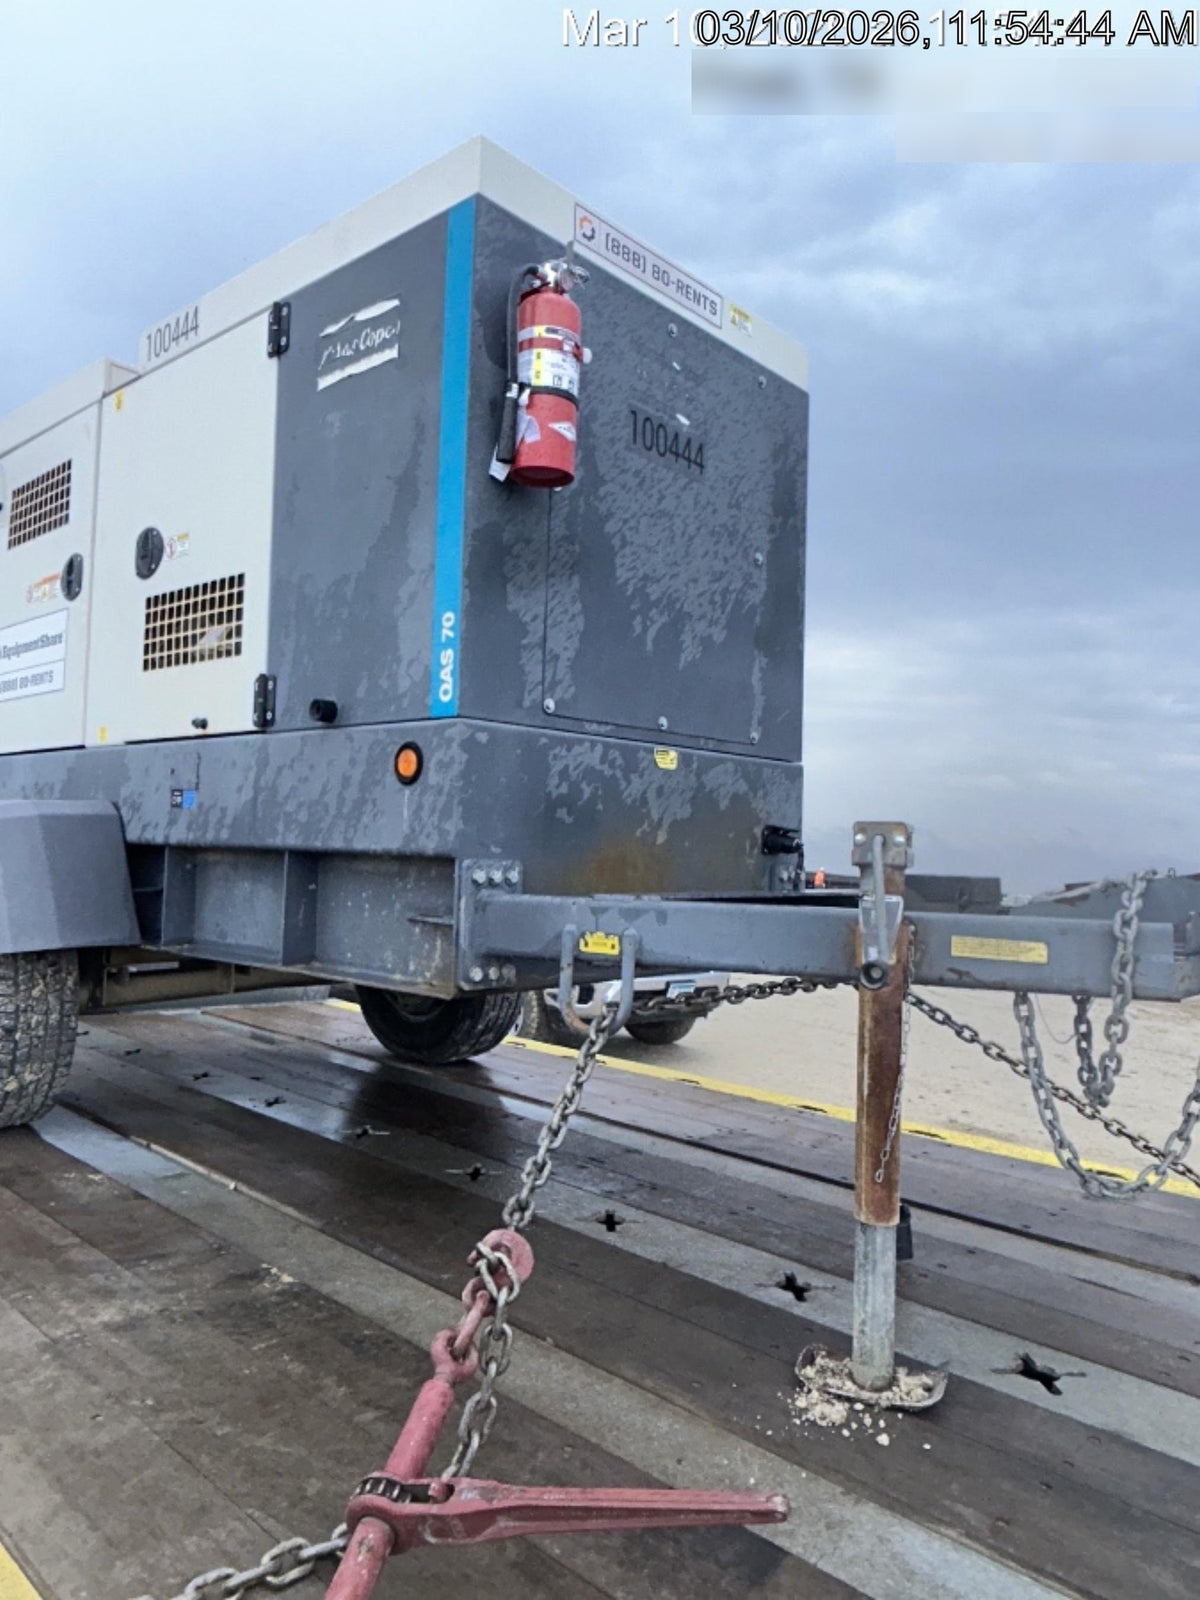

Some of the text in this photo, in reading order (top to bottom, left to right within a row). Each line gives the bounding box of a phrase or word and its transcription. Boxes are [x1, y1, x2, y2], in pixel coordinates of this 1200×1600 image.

[605, 231, 718, 317] (888) 80-RENTS
[146, 304, 200, 363] 100444
[630, 410, 705, 475] 100444
[438, 611, 456, 703] QAS 70
